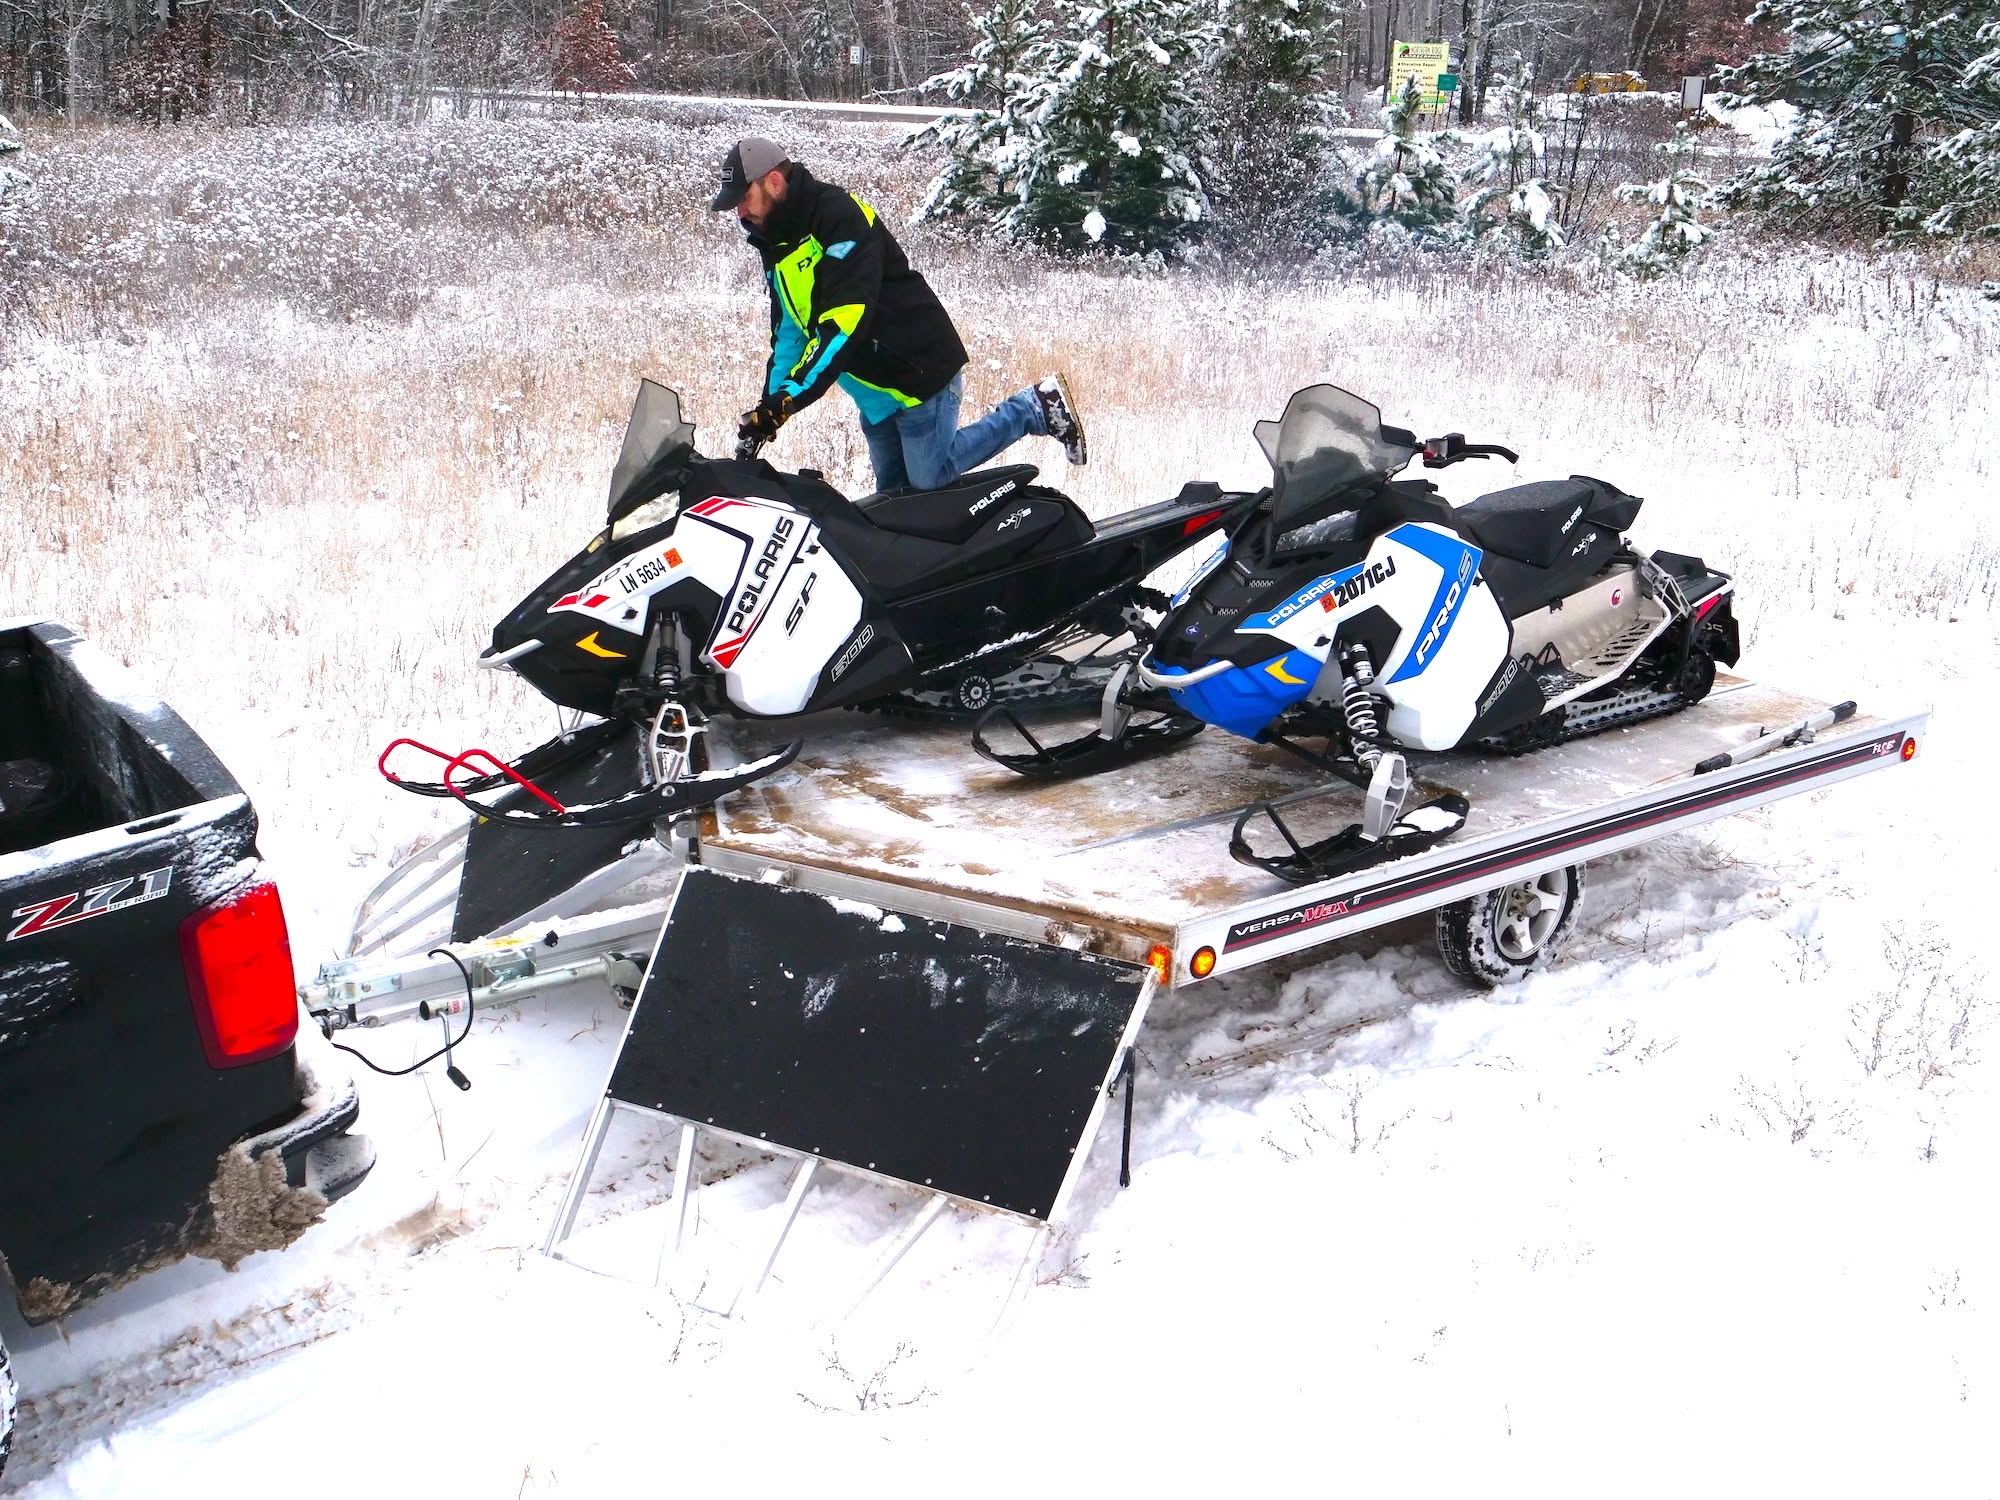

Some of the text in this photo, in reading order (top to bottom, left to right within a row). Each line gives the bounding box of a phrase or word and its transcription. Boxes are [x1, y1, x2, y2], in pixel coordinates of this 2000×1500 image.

[968, 480, 1016, 516] POLARIS
[1560, 505, 1583, 535] POLARIS
[619, 557, 667, 594] LN 5634
[666, 554, 678, 564] 22
[727, 514, 796, 634] POLARIS
[1266, 577, 1337, 626] POLARIS
[1321, 597, 1334, 609] 22
[1334, 555, 1396, 608] 2071CJ
[784, 571, 818, 640] SP
[831, 625, 875, 683] 600
[5, 865, 174, 942] Z71
[109, 889, 167, 910] OFF ROAD
